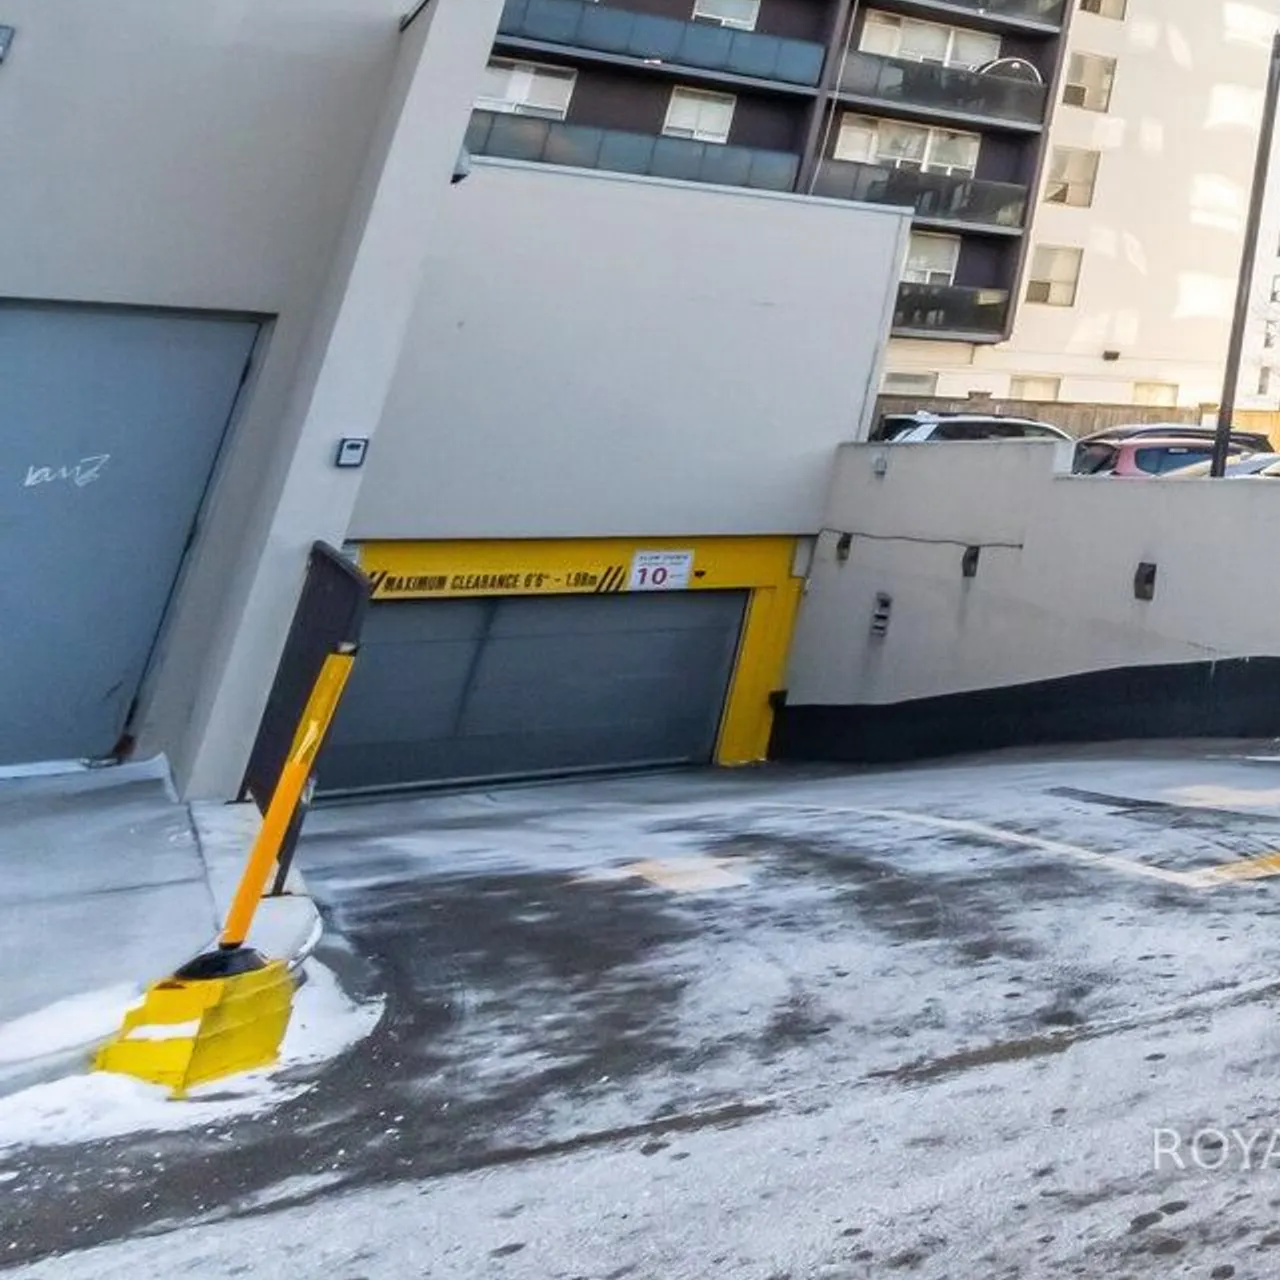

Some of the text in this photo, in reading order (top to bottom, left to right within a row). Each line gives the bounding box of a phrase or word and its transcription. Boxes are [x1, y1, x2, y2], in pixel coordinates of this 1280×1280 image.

[383, 575, 447, 591] MAXIMUM
[451, 574, 520, 589] CLEARANCE
[638, 566, 668, 586] 10
